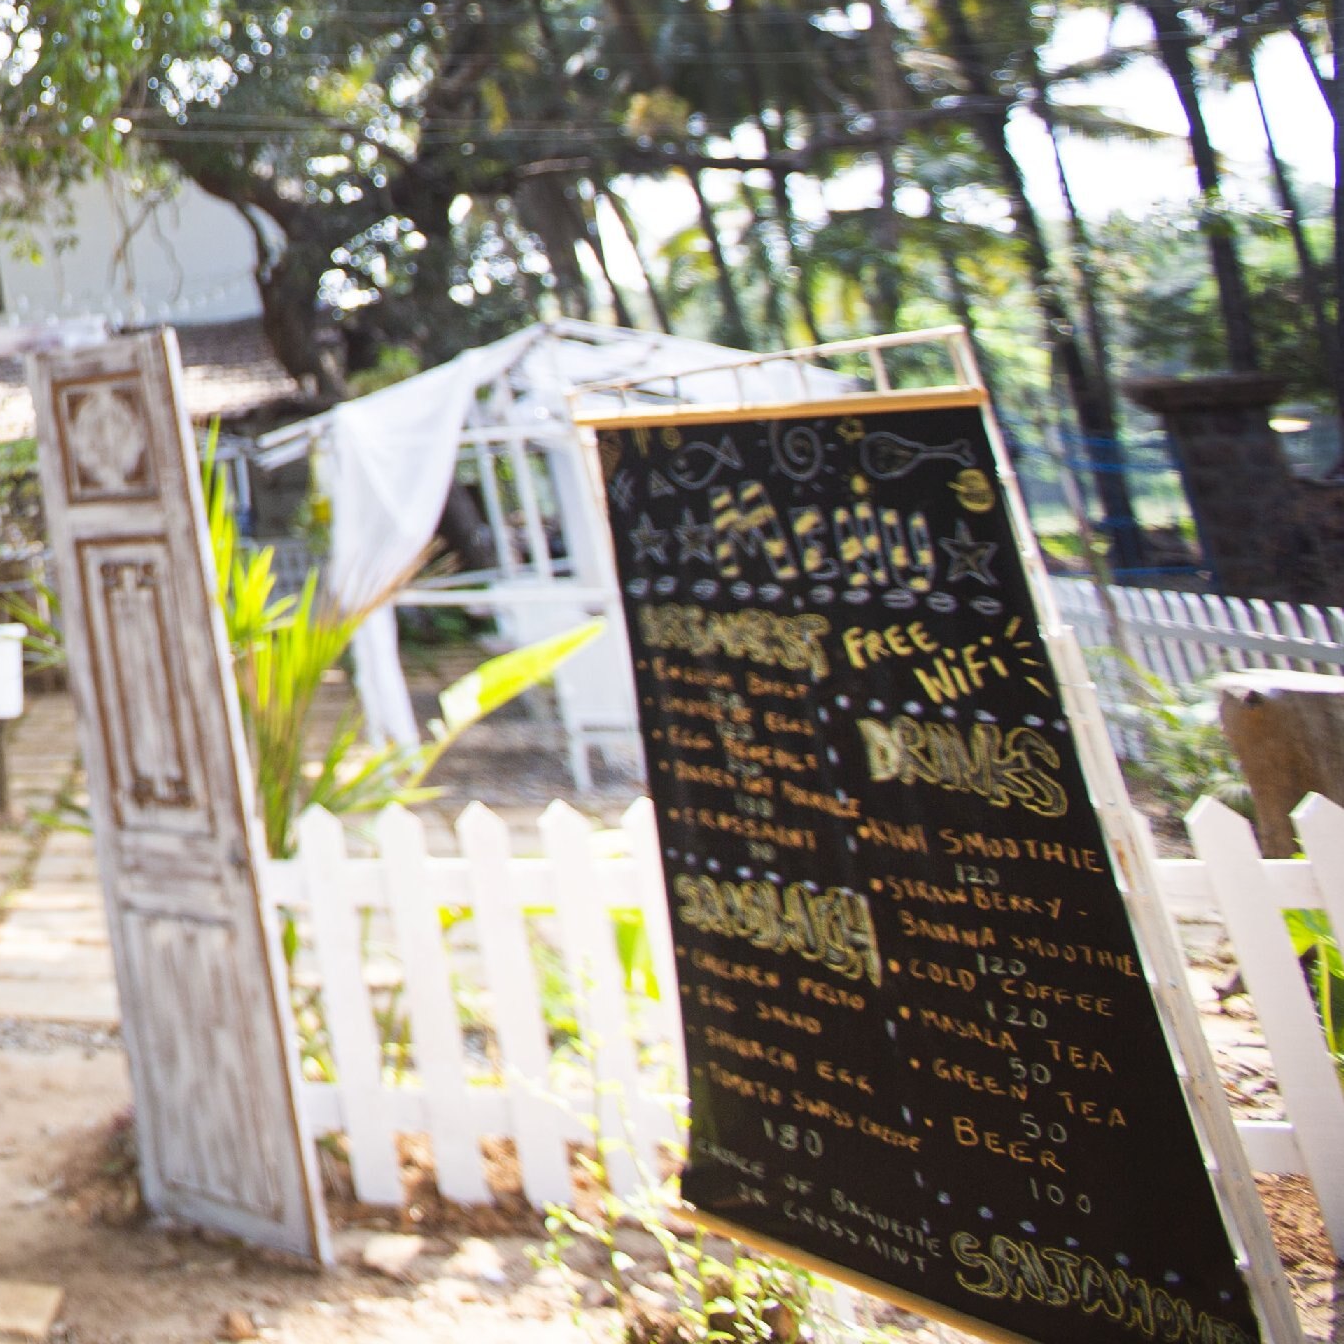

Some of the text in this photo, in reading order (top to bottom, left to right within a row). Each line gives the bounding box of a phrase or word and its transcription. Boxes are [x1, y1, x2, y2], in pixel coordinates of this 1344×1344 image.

[842, 621, 939, 669] FREE
[856, 714, 1069, 817] DRINKS
[939, 828, 1104, 873] SMOOTHIE
[954, 863, 1000, 886] 120
[976, 953, 1027, 977] 120
[1009, 934, 1139, 977] SMOOTHIE
[909, 959, 1113, 1016] COLD COFFEE
[984, 1000, 1048, 1029] 120
[920, 1009, 1113, 1074] MASALA TEA
[1009, 1057, 1051, 1084] 50
[932, 1058, 1127, 1127] GREEN TEA
[763, 1117, 824, 1158] 180
[953, 1116, 1065, 1173] BEER
[1020, 1113, 1068, 1143] 50
[1028, 1177, 1091, 1214] 100
